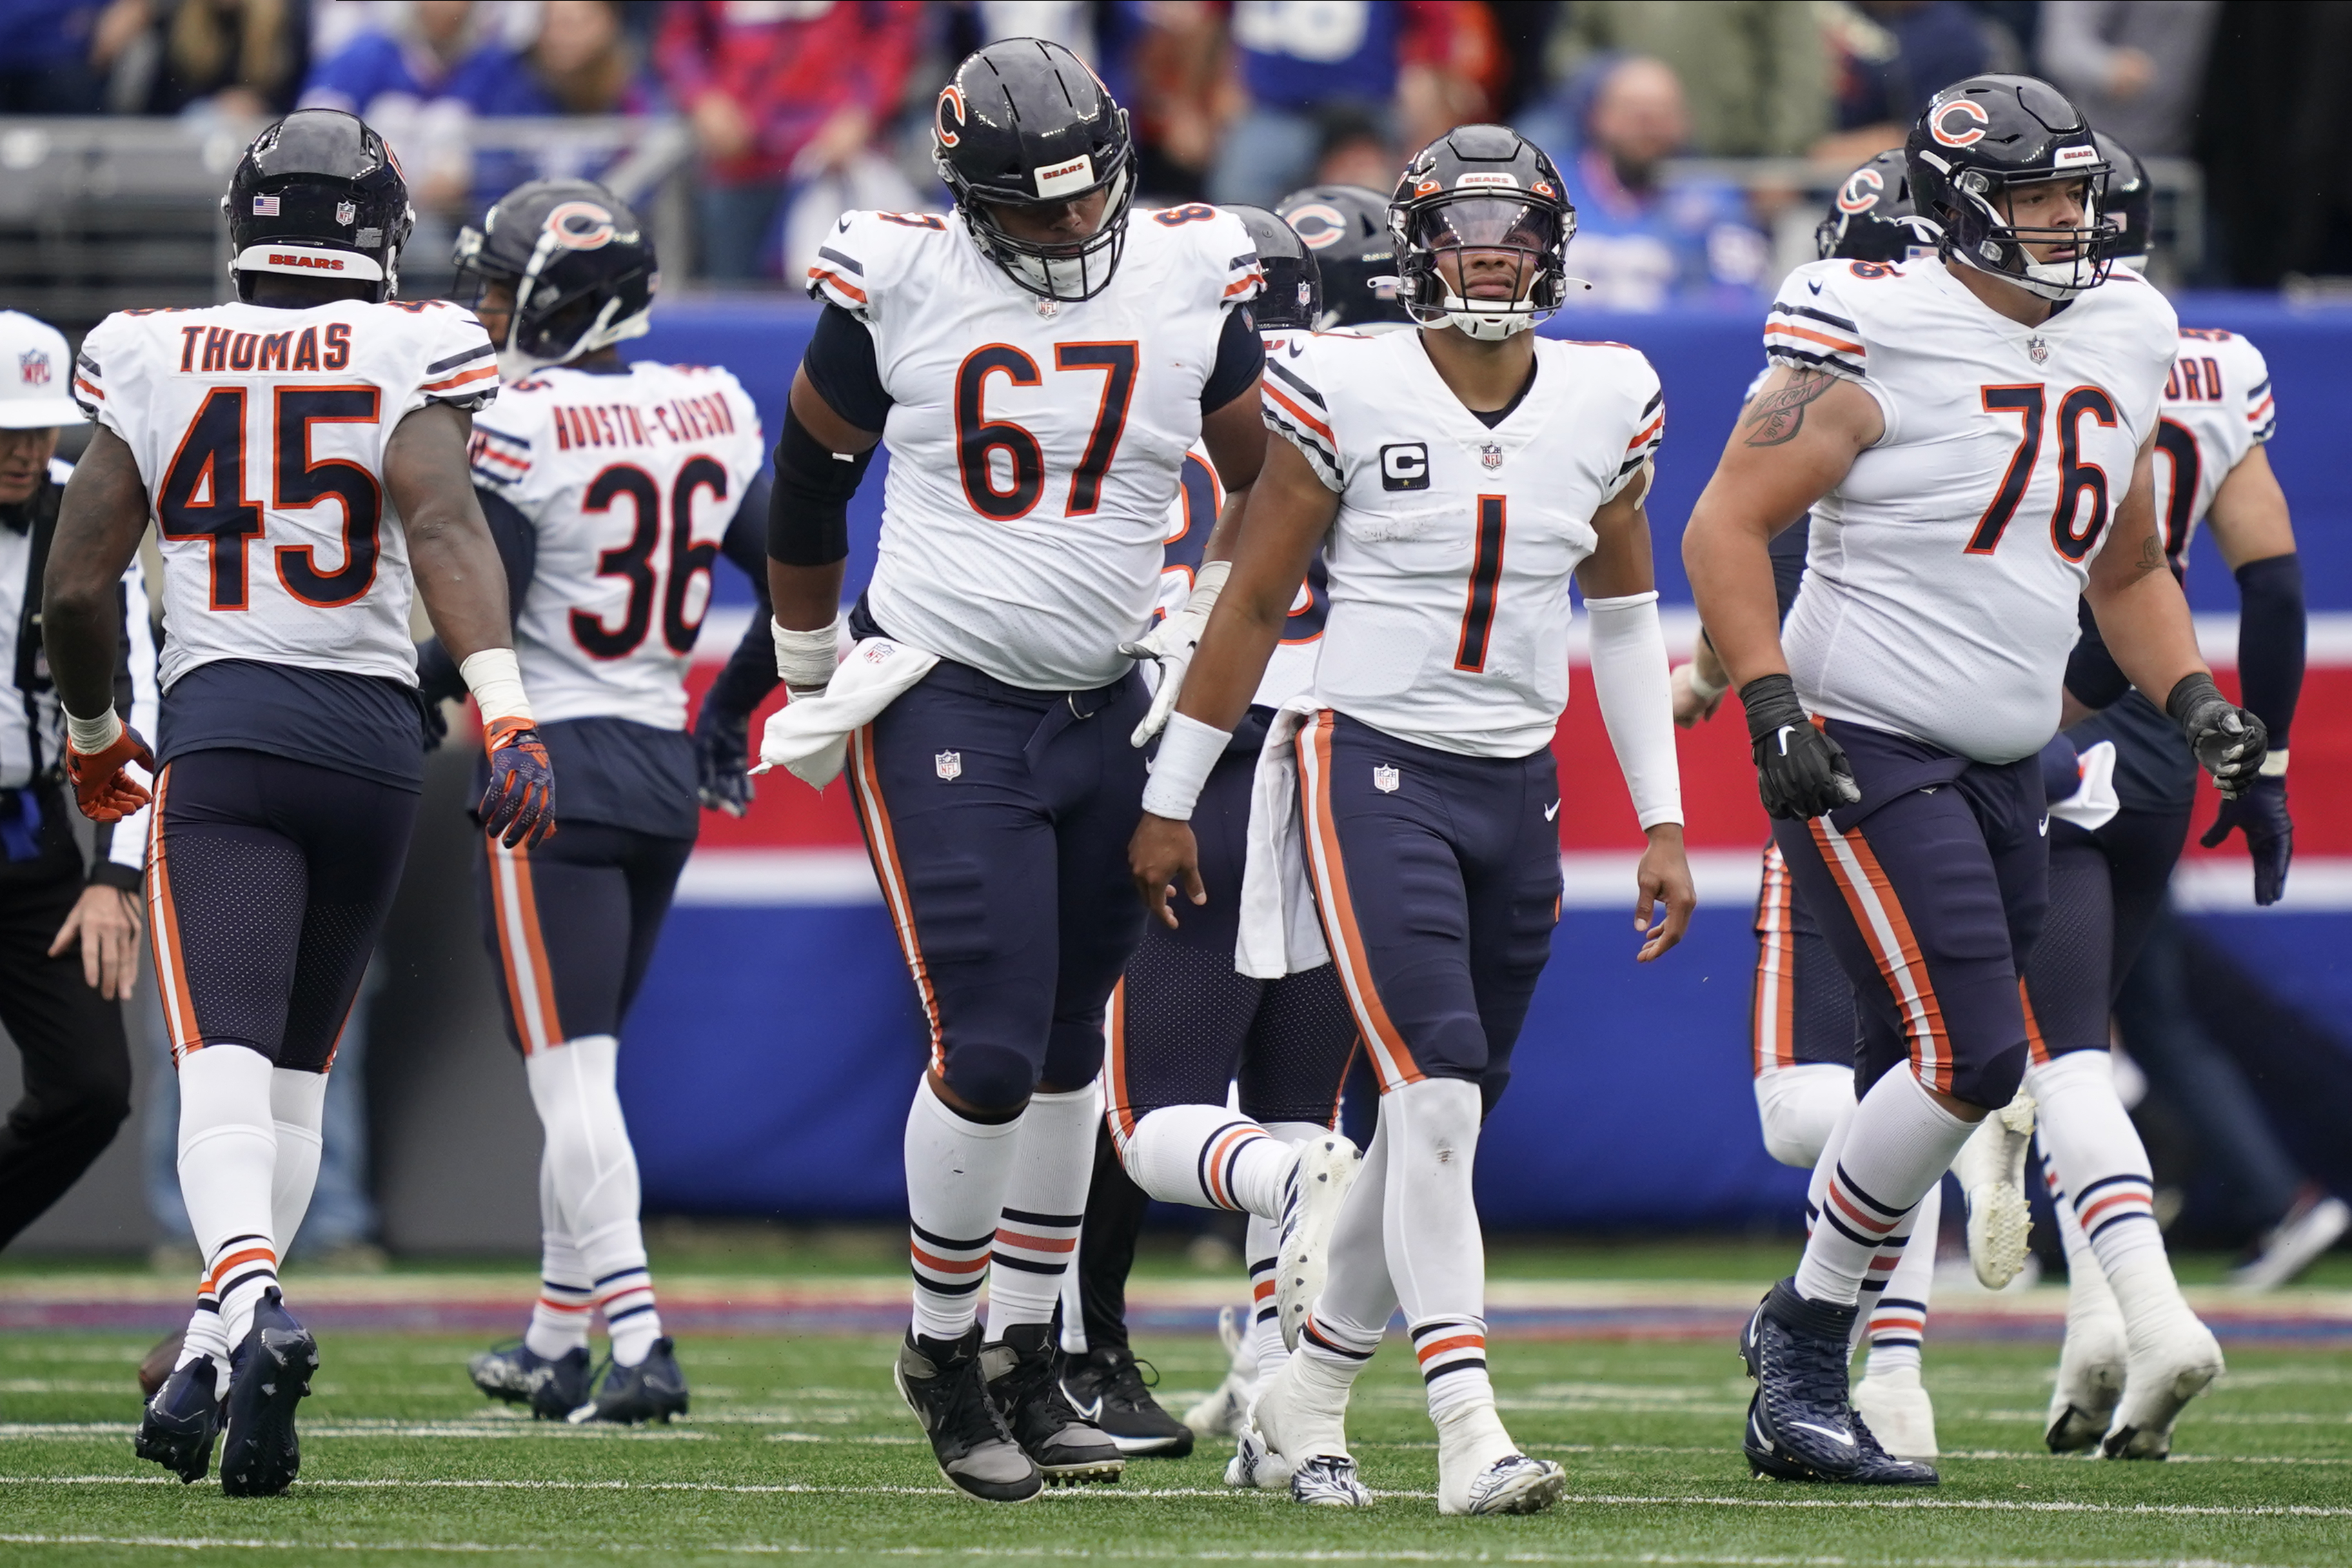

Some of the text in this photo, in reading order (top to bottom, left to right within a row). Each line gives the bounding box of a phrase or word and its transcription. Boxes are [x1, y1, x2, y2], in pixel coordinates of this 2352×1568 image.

[2064, 150, 2093, 159] BEARS
[1042, 162, 1084, 180] BEARS
[269, 254, 344, 270] BEARS
[1040, 302, 1056, 314] NFL
[181, 322, 352, 372] THOMAS
[23, 364, 50, 384] NFL
[955, 340, 1140, 521] 67
[1385, 446, 1425, 479] C
[1485, 455, 1500, 465] NFL
[1964, 383, 2117, 563] 76
[157, 385, 382, 611] 45
[569, 455, 729, 660] 36
[1454, 494, 1507, 673] 1
[868, 649, 885, 664] NFL
[941, 764, 957, 774] NFL
[1379, 777, 1394, 787] NFL
